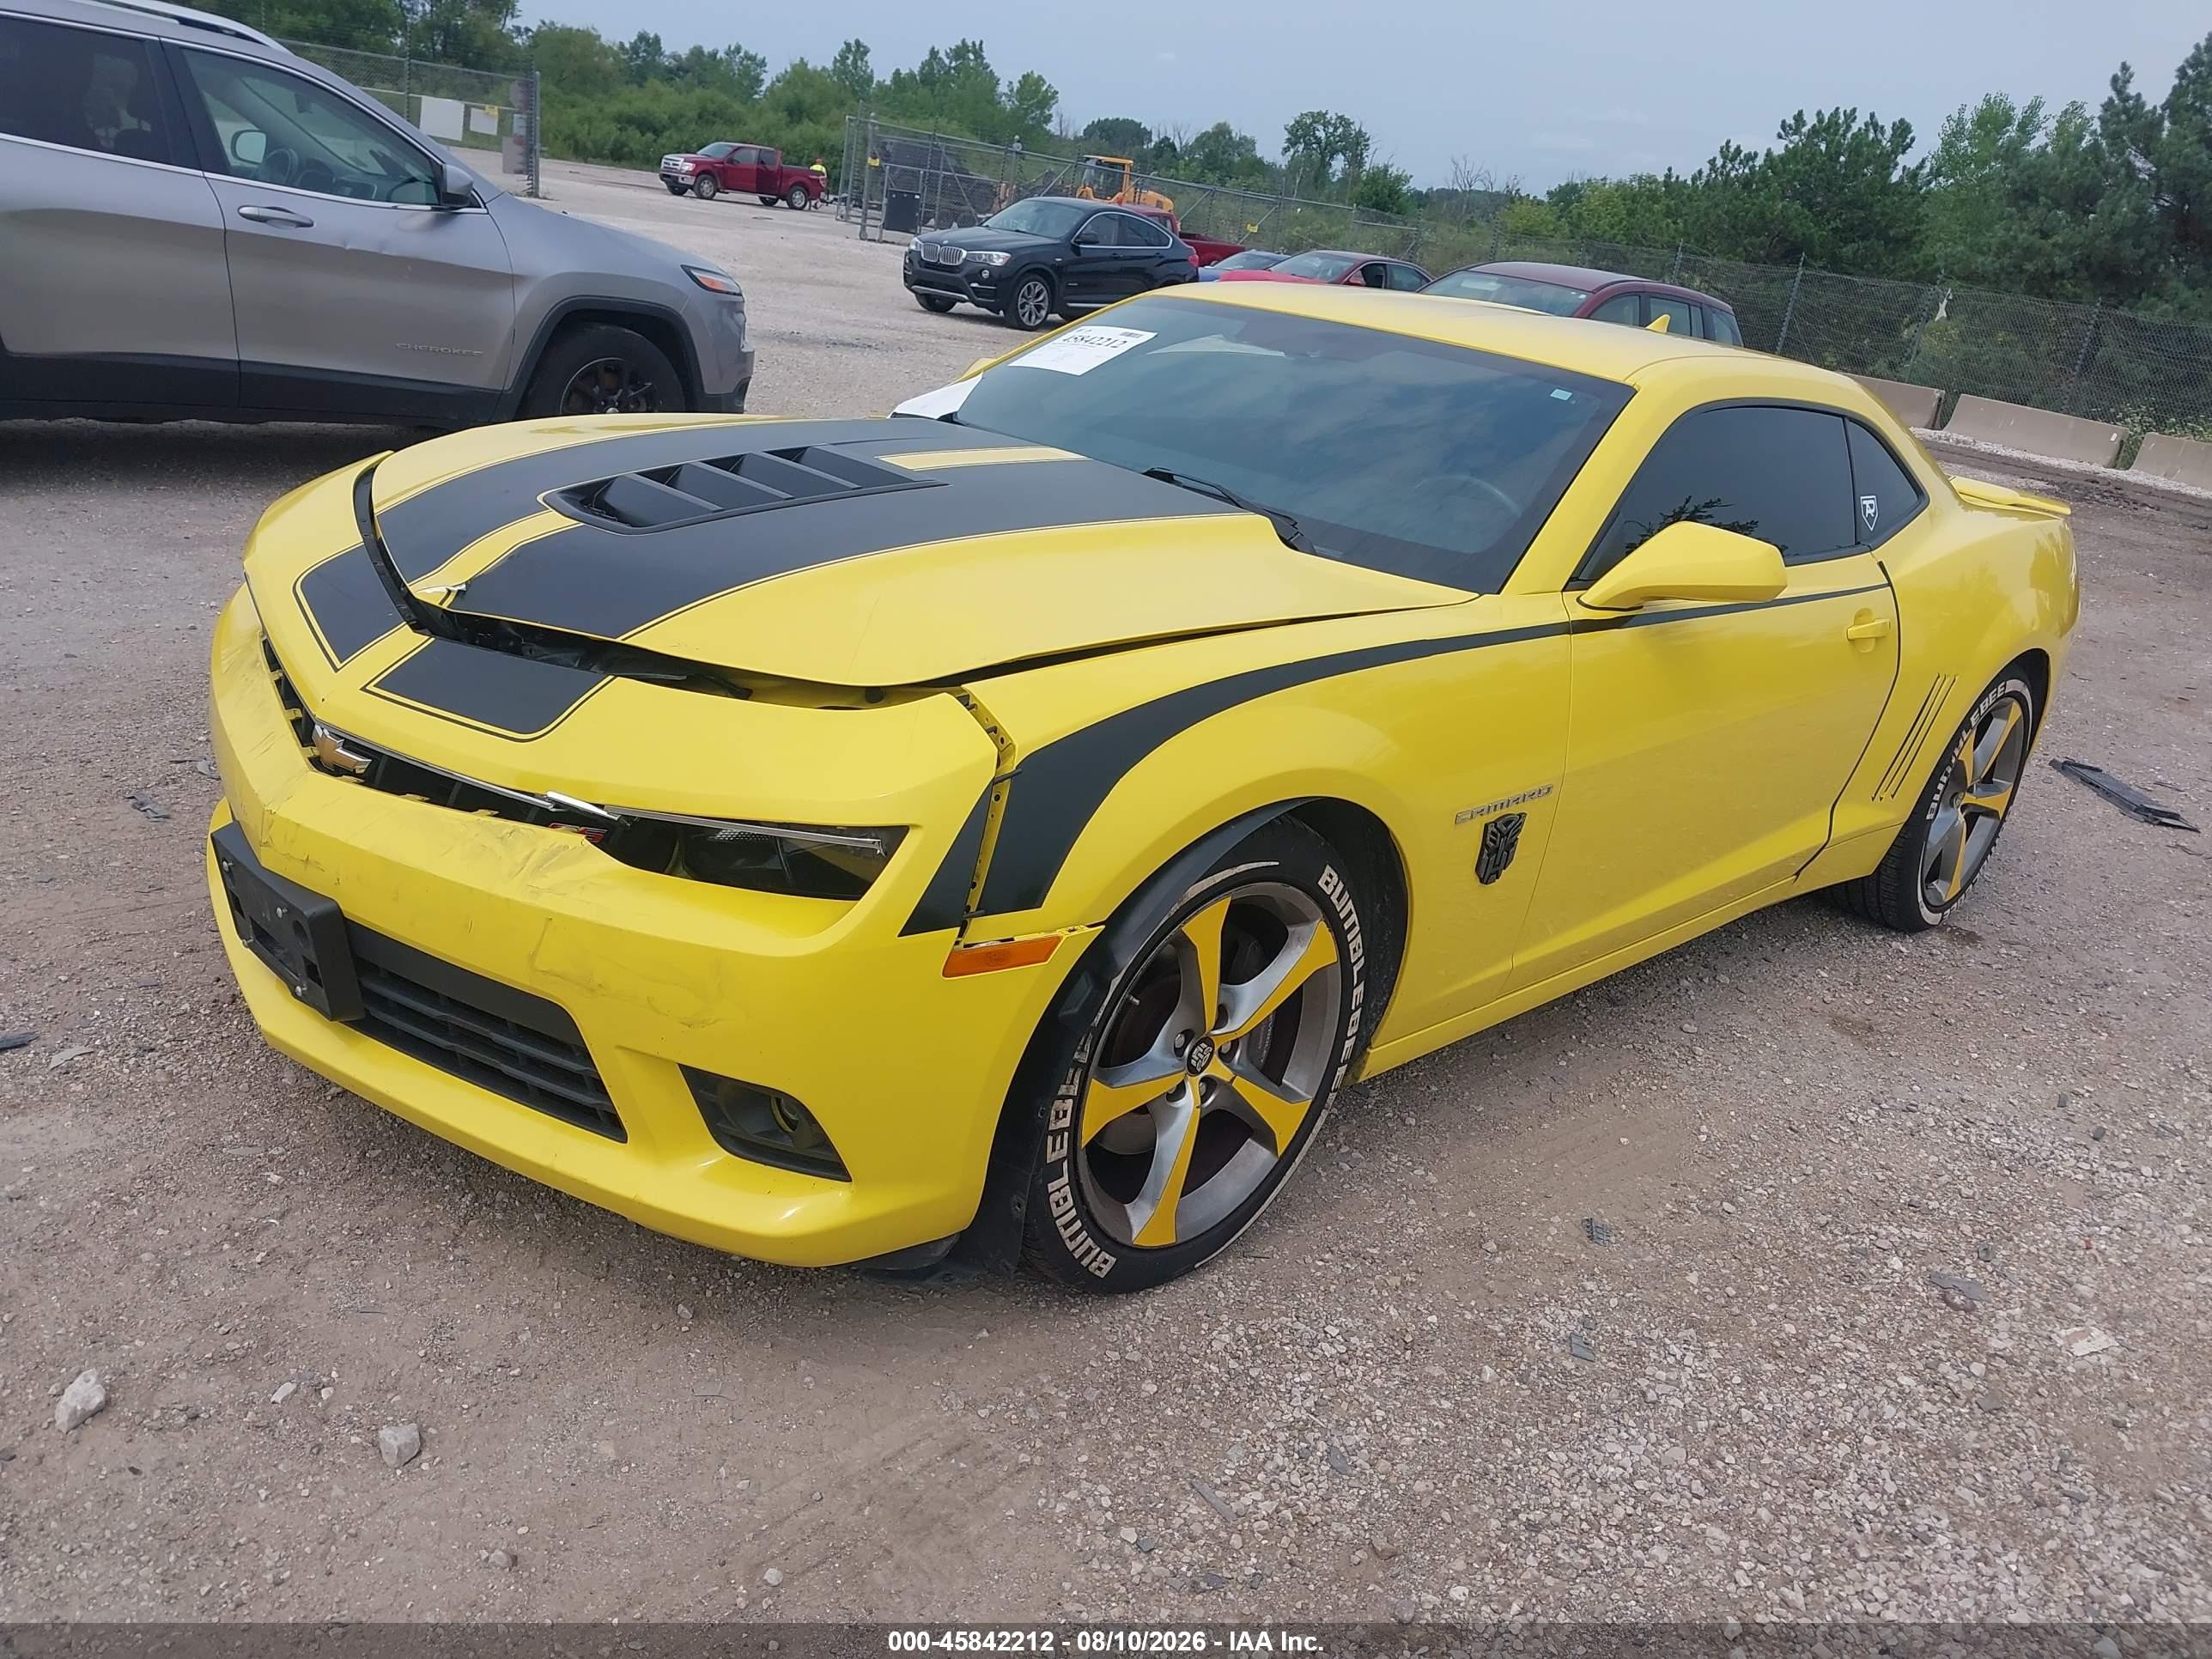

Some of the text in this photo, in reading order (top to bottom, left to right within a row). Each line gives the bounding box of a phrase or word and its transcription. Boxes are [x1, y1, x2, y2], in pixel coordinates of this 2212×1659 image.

[395, 343, 484, 356] CHEROKEE
[1455, 783, 1554, 825] CAMARO
[1316, 863, 1366, 1092] BUMBLEBEE
